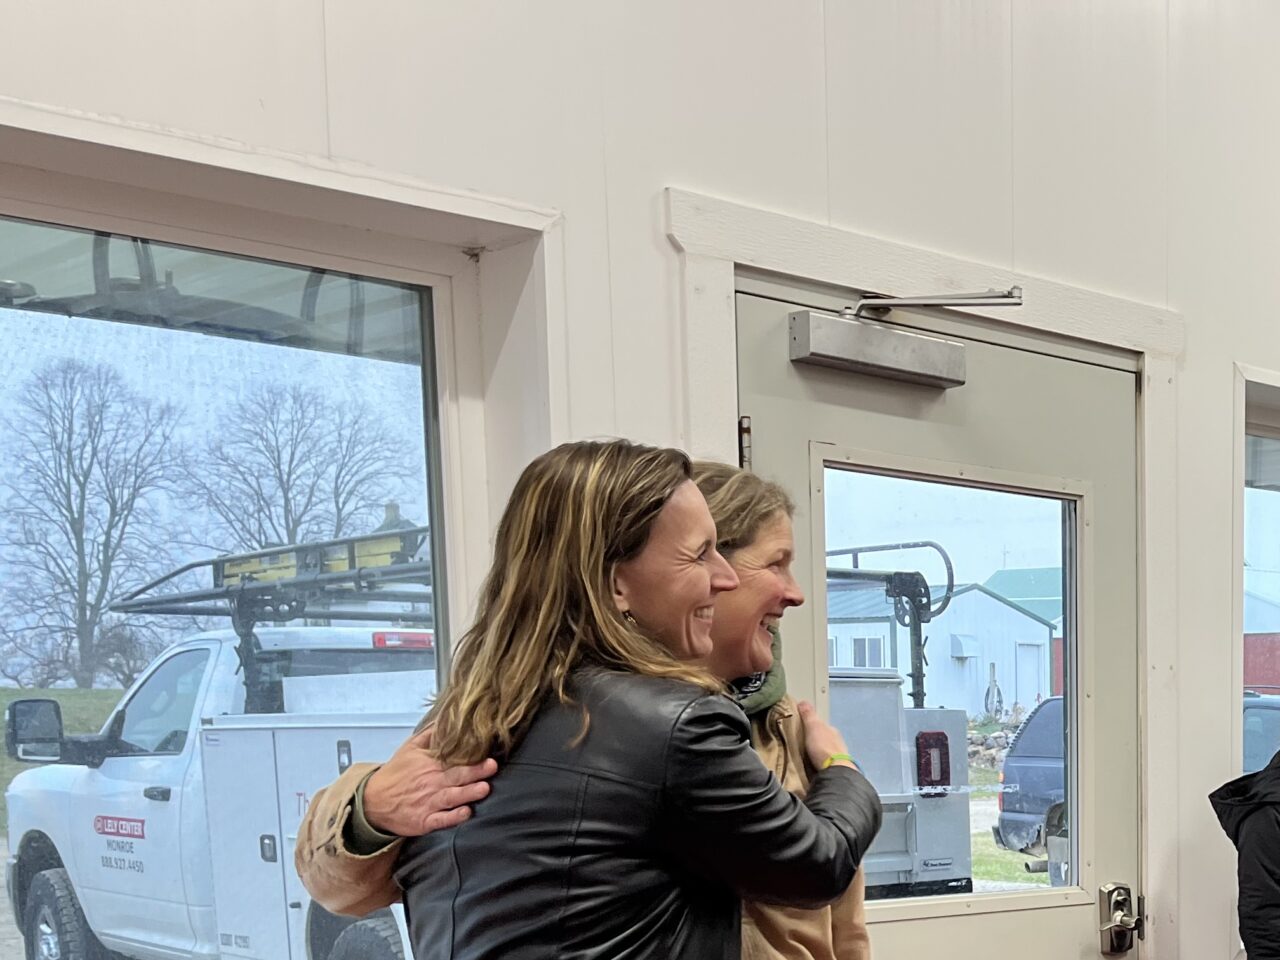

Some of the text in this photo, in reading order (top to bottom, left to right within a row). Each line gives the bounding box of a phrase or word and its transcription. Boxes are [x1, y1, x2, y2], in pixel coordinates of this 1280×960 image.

[104, 819, 142, 835] LELY CENTER
[106, 839, 134, 854] MONROE
